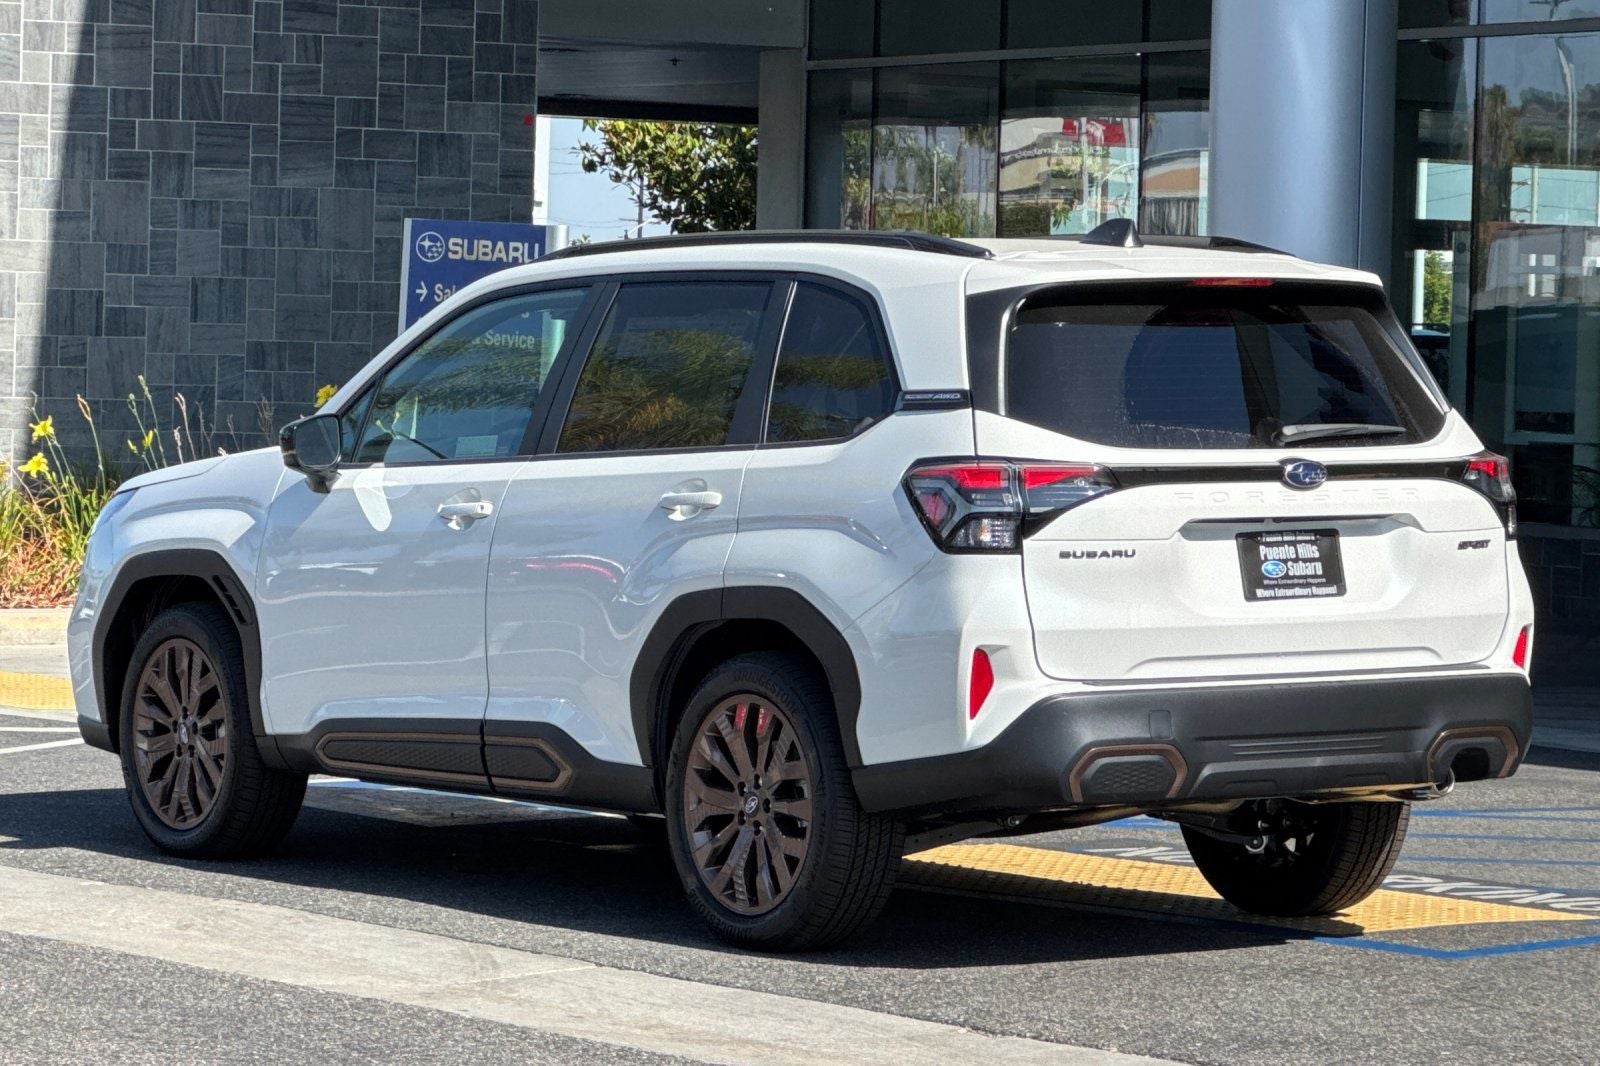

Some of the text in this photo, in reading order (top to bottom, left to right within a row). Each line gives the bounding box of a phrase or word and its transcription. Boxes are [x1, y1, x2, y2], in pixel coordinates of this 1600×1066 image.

[448, 237, 539, 264] SUBARU
[484, 329, 535, 349] Service
[1173, 487, 1420, 503] FORESTER
[1059, 548, 1136, 559] SUBARU
[1259, 542, 1320, 560] Puente Hills
[1287, 560, 1323, 576] Subaru
